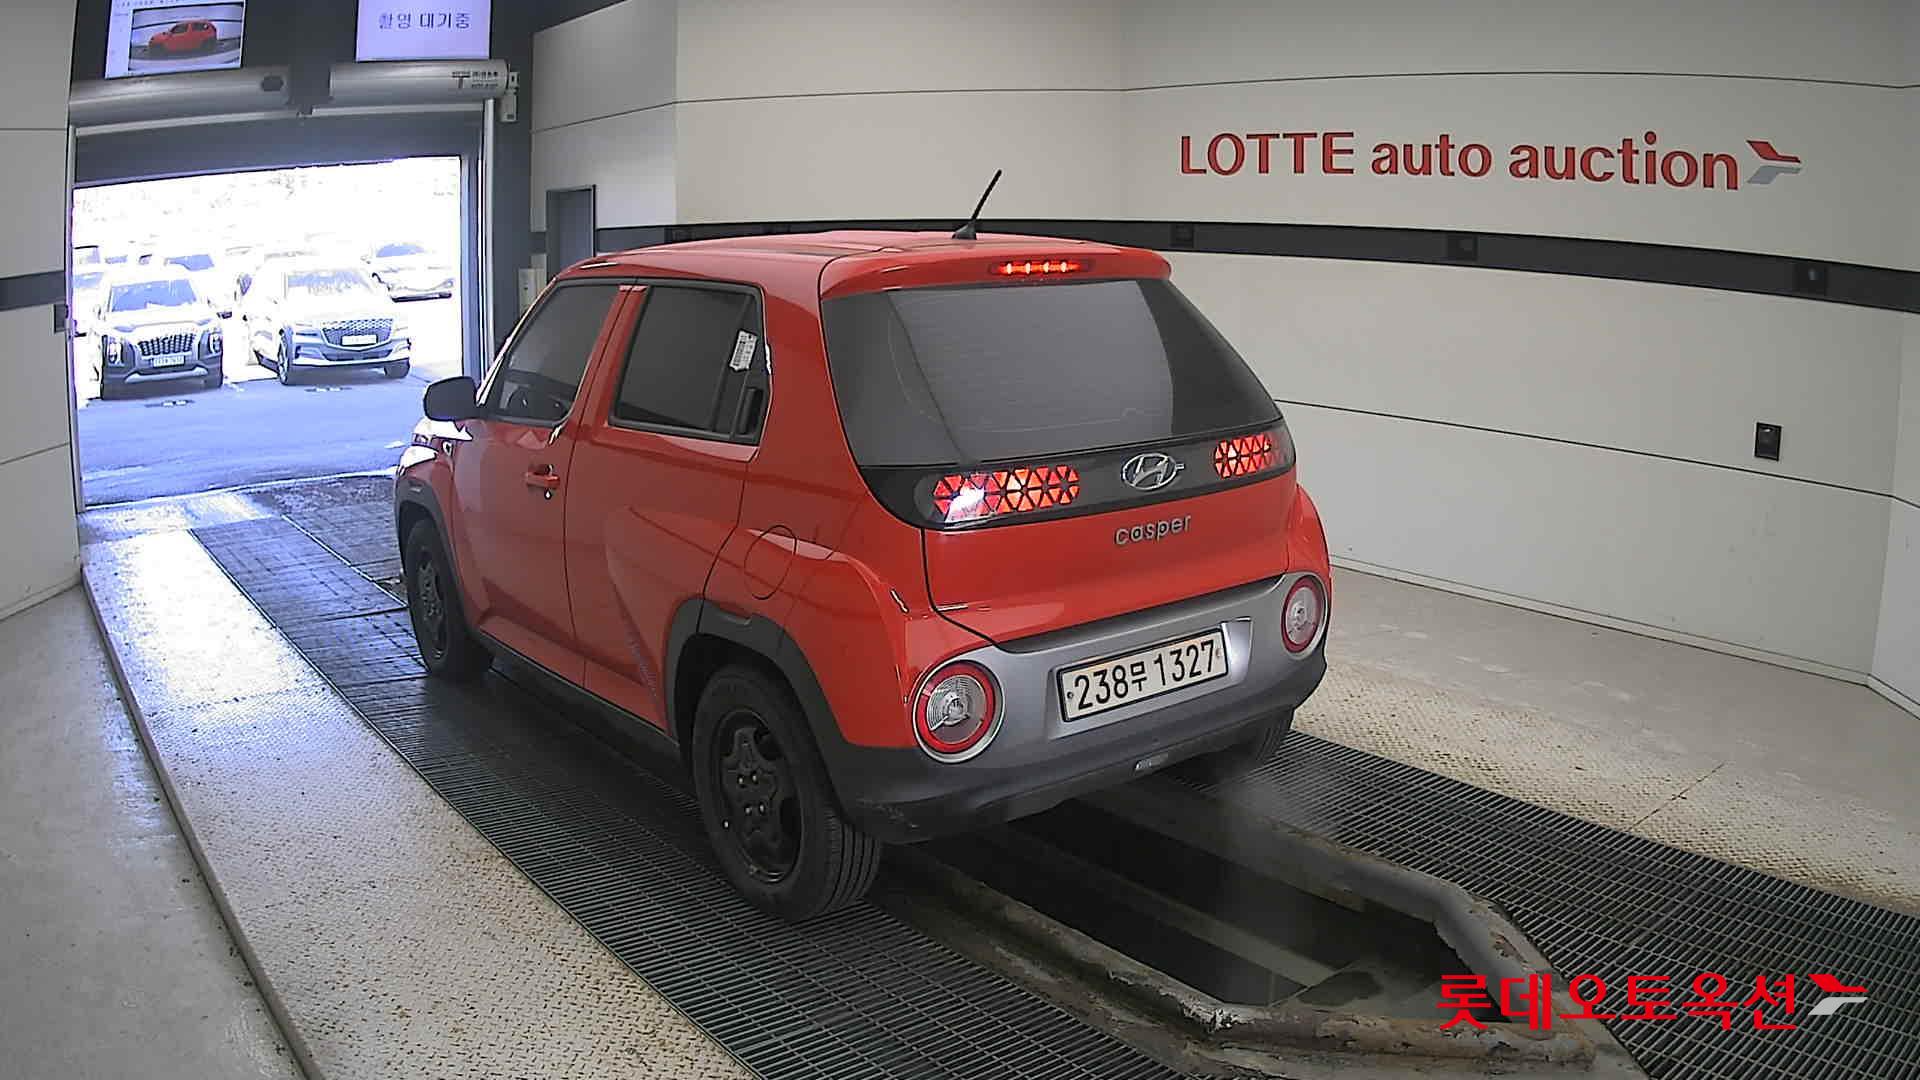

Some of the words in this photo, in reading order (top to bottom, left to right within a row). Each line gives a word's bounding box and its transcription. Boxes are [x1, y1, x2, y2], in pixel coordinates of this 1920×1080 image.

[419, 13, 471, 29] 대기중
[1181, 132, 1354, 175] LOTTE
[1371, 134, 1492, 177] auto
[1508, 130, 1739, 190] auction
[1114, 515, 1192, 545] casper
[1074, 661, 1148, 710] 238무
[1154, 639, 1215, 686] 1327
